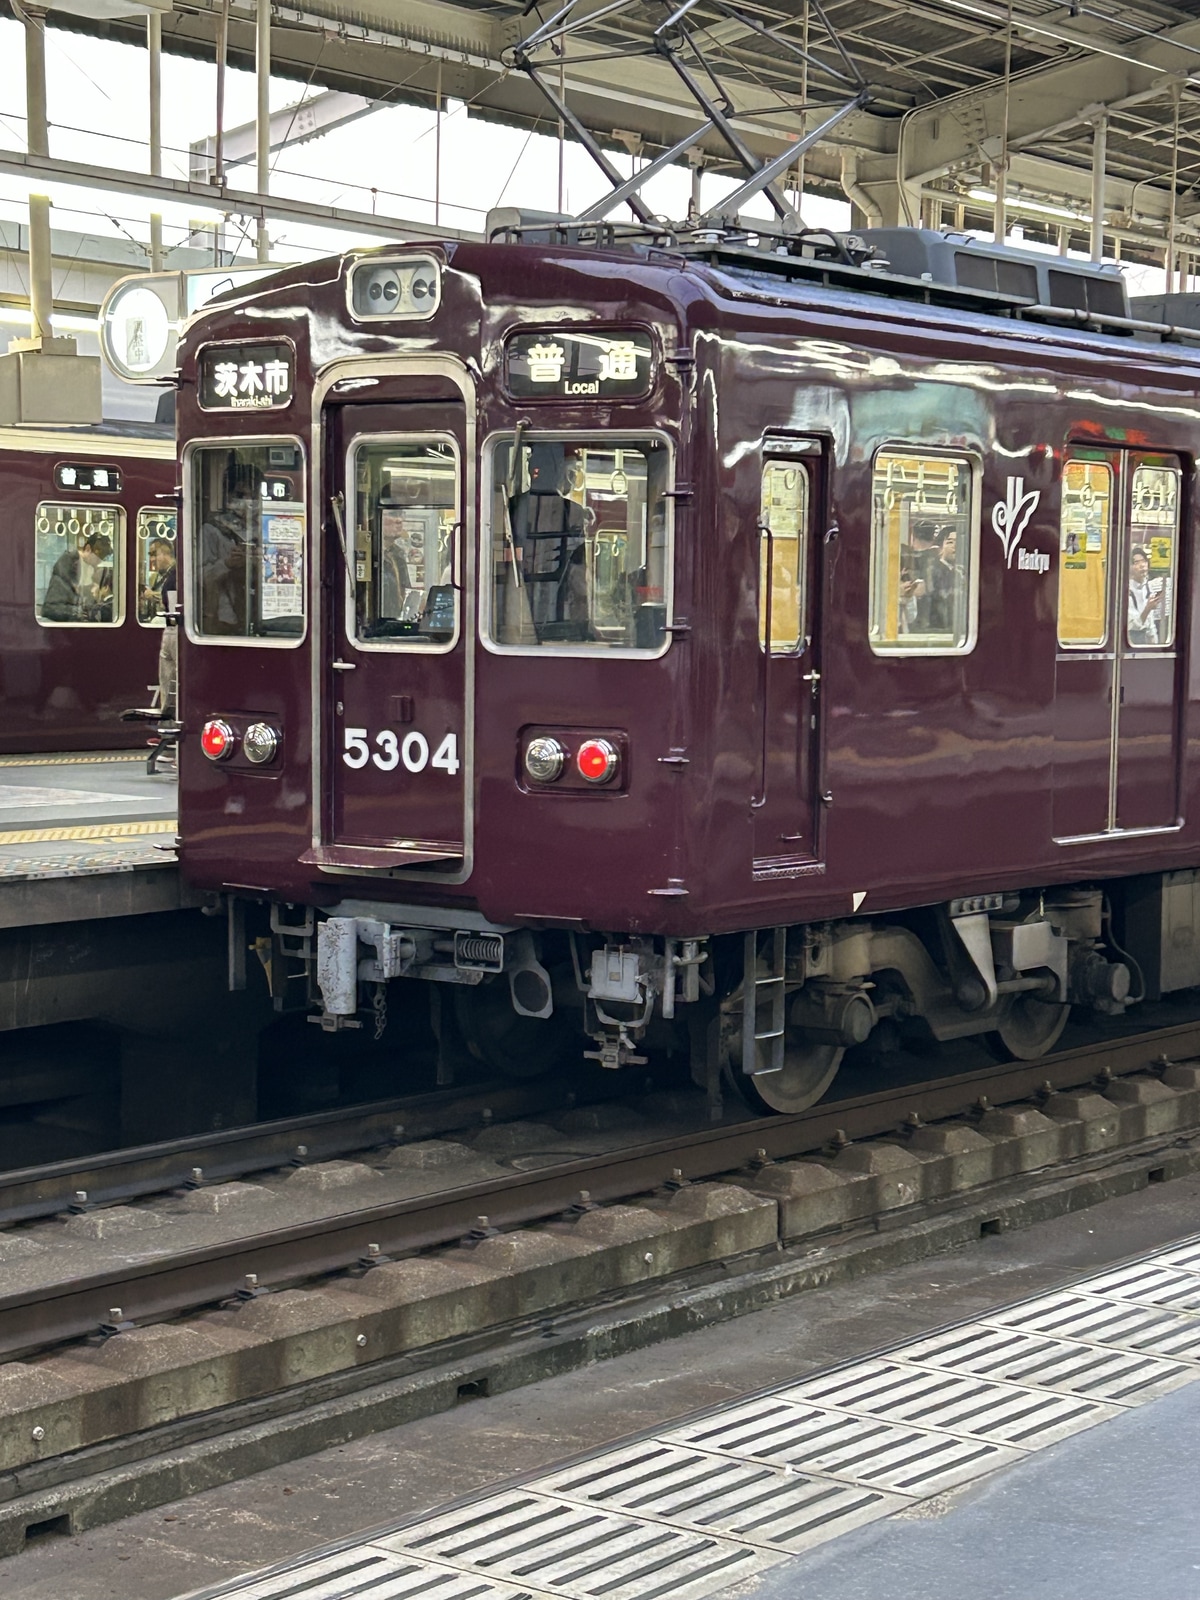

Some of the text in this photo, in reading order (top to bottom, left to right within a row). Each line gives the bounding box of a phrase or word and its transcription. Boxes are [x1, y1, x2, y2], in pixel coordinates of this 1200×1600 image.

[214, 359, 289, 398] 茨木市
[527, 341, 638, 382] 普通
[564, 380, 600, 395] Local
[342, 727, 460, 775] 5304
